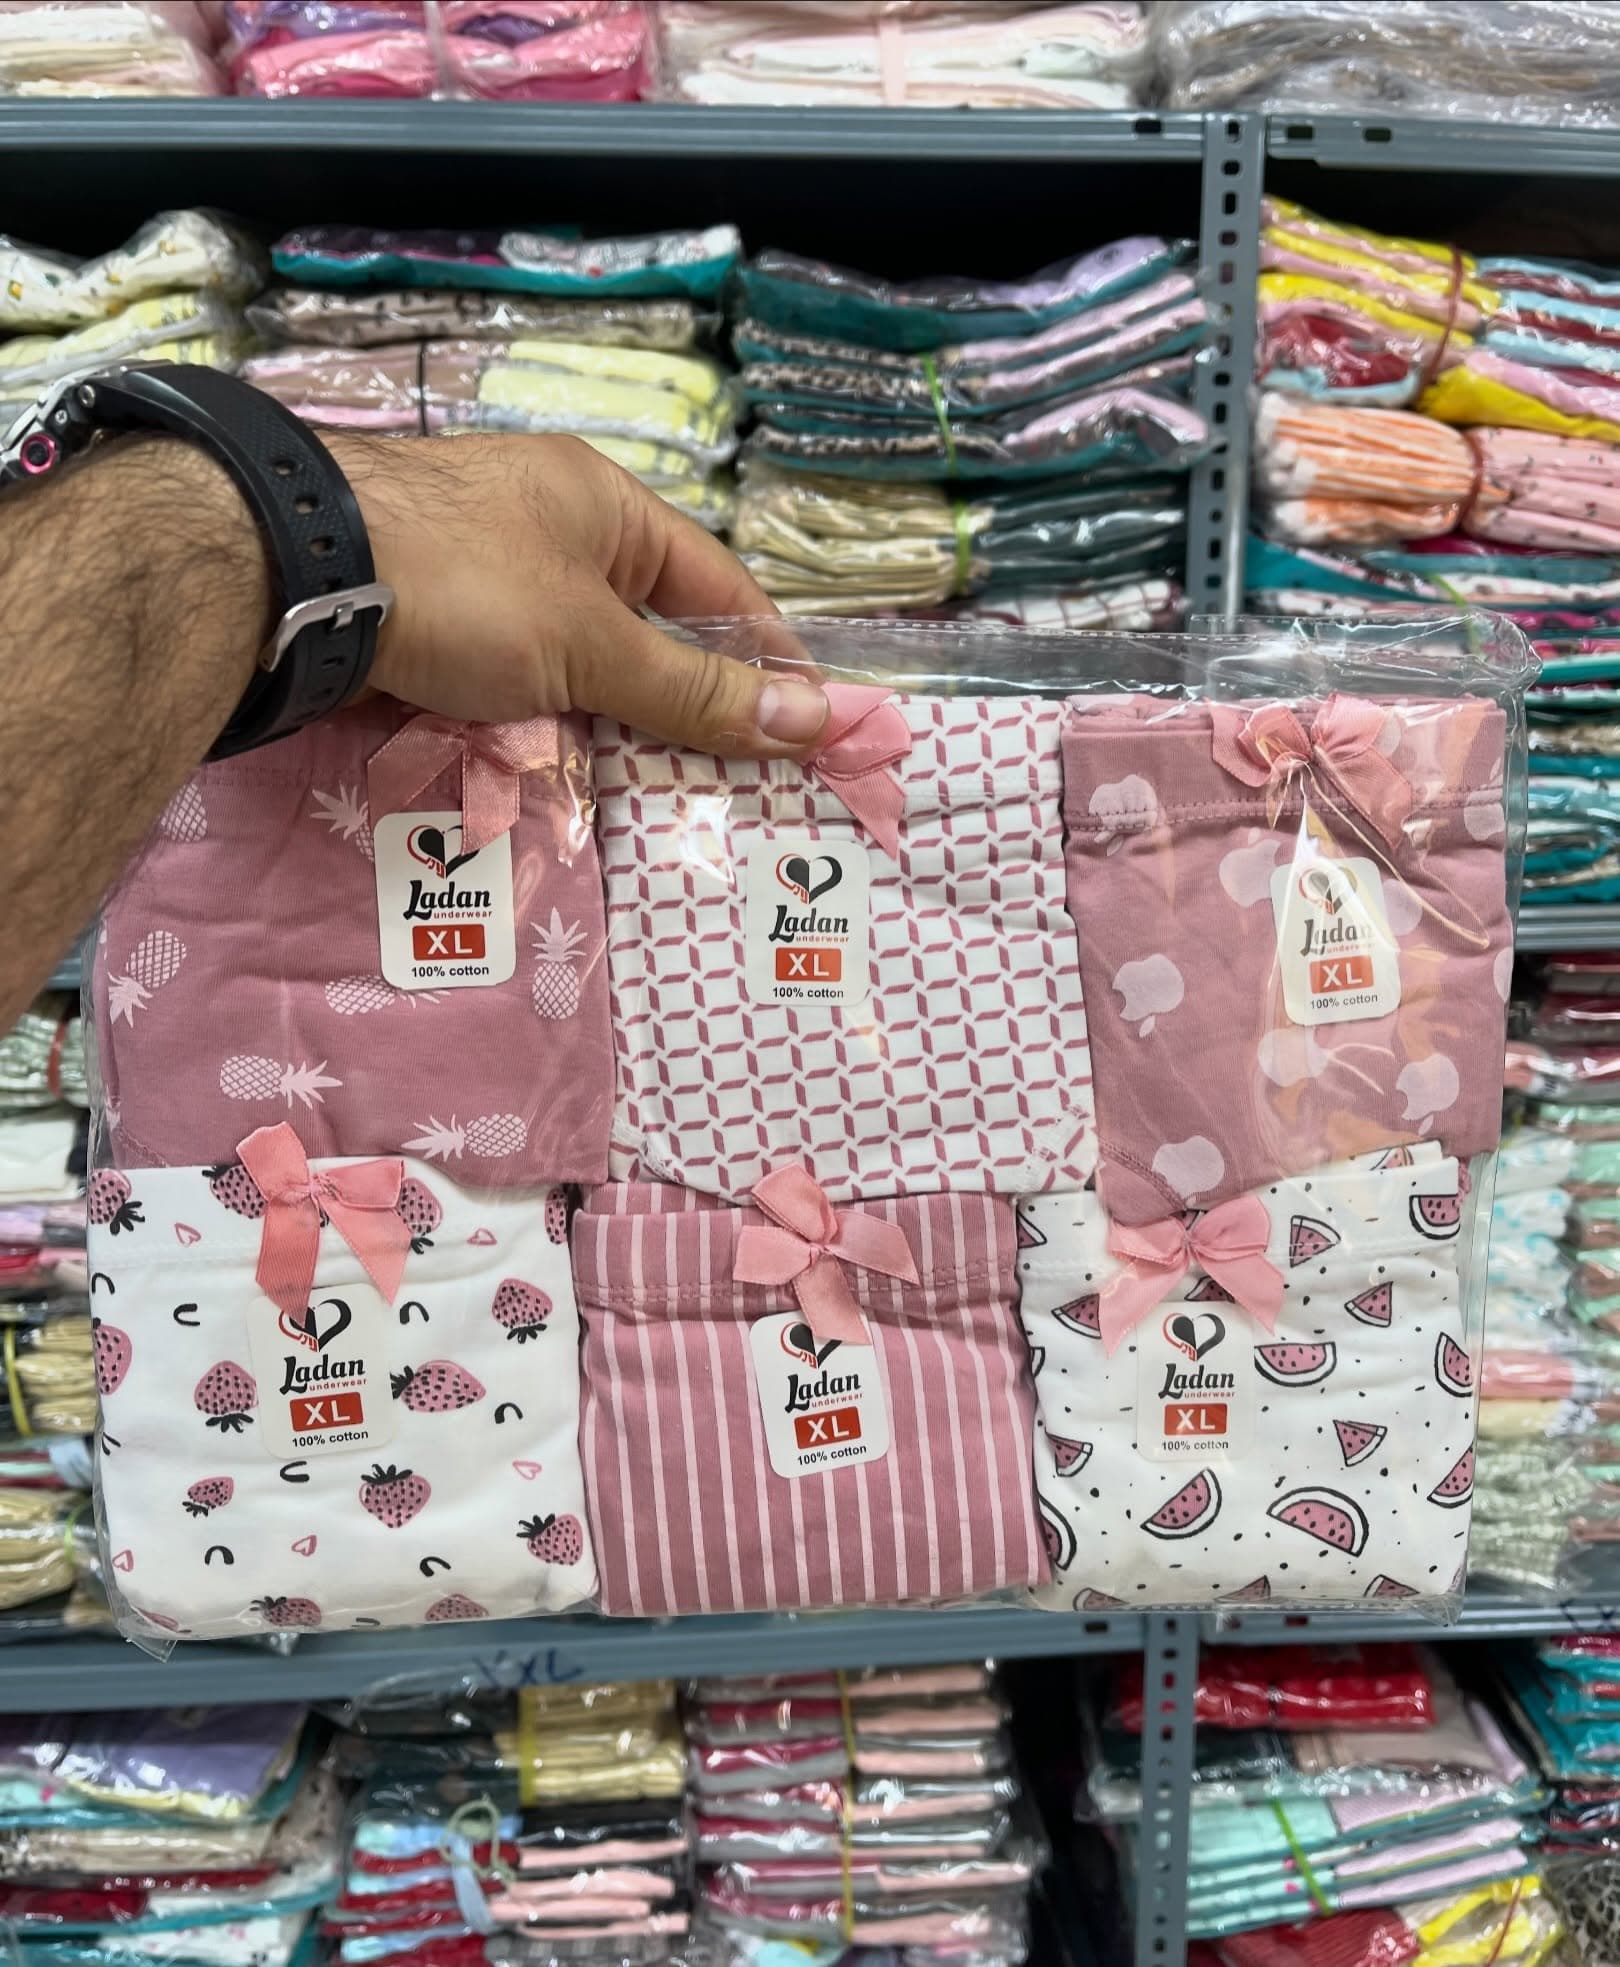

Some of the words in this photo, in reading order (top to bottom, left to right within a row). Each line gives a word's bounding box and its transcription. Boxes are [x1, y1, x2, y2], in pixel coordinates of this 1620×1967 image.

[403, 880, 491, 920] Ladan
[434, 910, 492, 919] underwear
[768, 905, 849, 943] Ladan
[427, 930, 473, 955] XL
[796, 935, 849, 943] underwear
[411, 966, 445, 977] 100%
[449, 965, 489, 976] cotton
[788, 953, 829, 976] XL
[1322, 962, 1362, 988] XL
[773, 987, 804, 998] 100%
[807, 987, 844, 998] cotton
[1311, 998, 1340, 1009] 100%
[1343, 995, 1378, 1006] cotton
[279, 1354, 366, 1395] Ladan
[1158, 1363, 1235, 1400] Ladan
[310, 1379, 367, 1392] underwear
[784, 1370, 861, 1414] Ladan
[1184, 1391, 1235, 1399] underwear
[812, 1392, 863, 1408] underwear
[304, 1400, 350, 1426] XL
[1176, 1408, 1215, 1430] XL
[292, 1435, 326, 1447] 100%
[329, 1431, 369, 1443] cotton
[808, 1415, 849, 1443] XL
[797, 1452, 828, 1465] 100%
[831, 1445, 867, 1459] cotton
[1162, 1440, 1190, 1451] 100%
[1194, 1440, 1229, 1450] cotton
